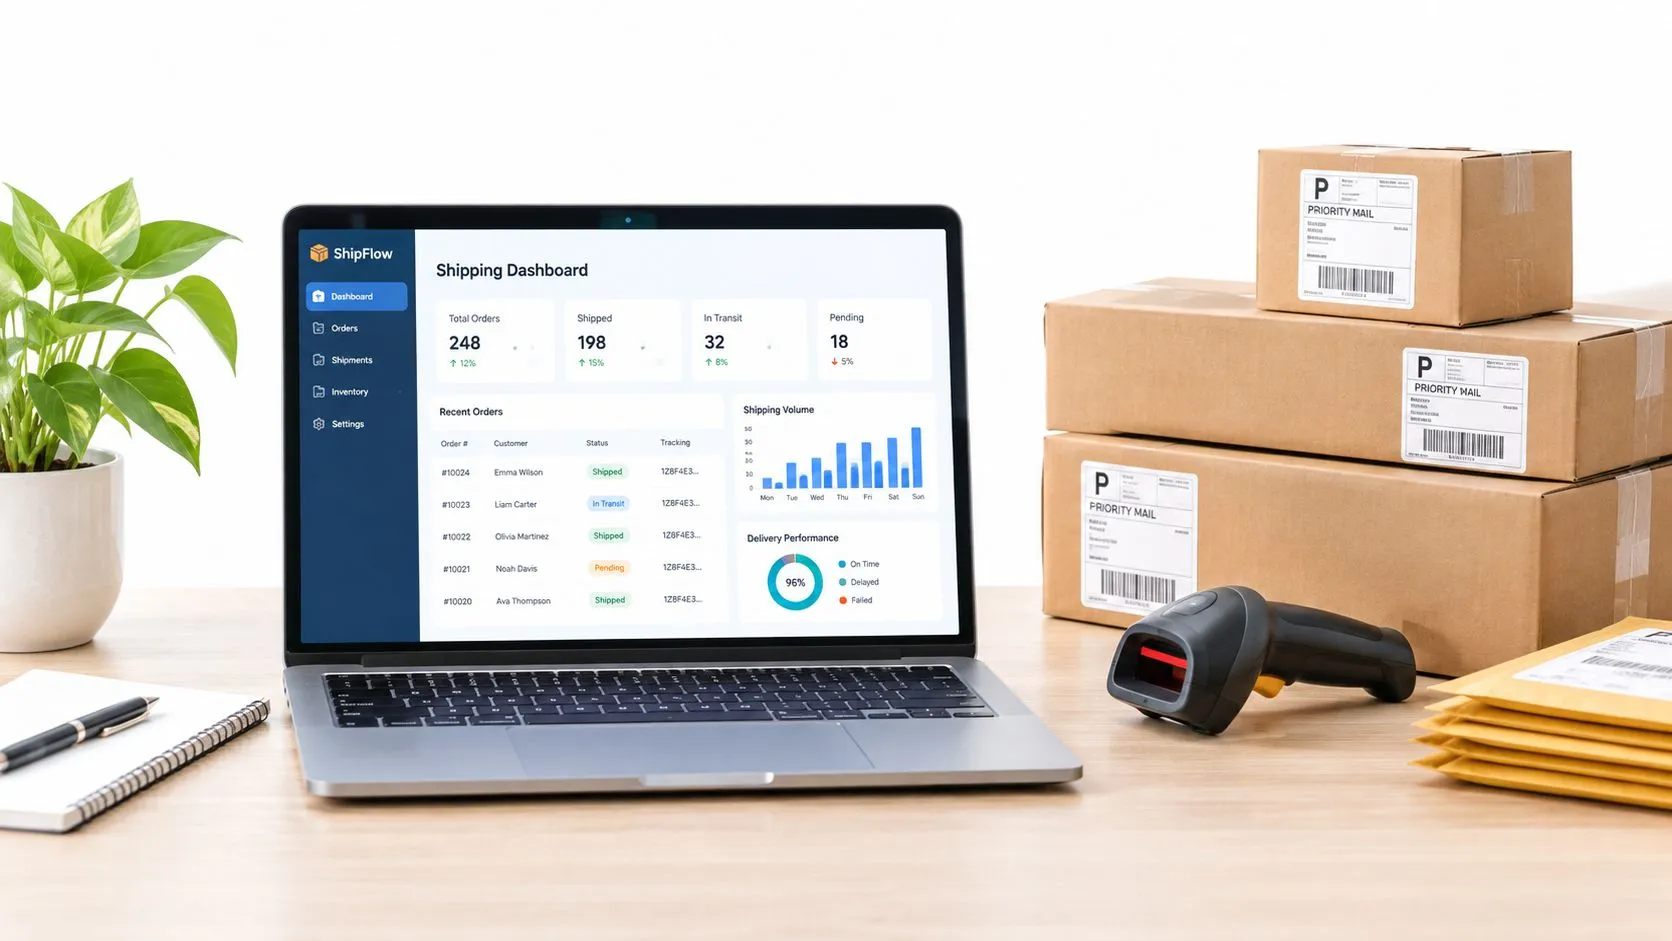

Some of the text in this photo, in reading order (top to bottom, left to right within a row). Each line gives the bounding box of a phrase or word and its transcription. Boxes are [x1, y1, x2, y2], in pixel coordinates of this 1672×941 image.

[1315, 177, 1328, 199] P
[1308, 205, 1374, 218] PRIORITY MAIL
[334, 248, 393, 263] ShipFlow
[437, 263, 588, 280] Shipping Dashboard
[449, 314, 500, 323] Total Orders
[578, 314, 612, 324] Shipped
[704, 314, 742, 323] In Transit
[830, 313, 864, 323] Pending
[332, 324, 358, 332] Orders
[450, 335, 480, 350] 248
[578, 334, 606, 349] 198
[705, 334, 724, 349] 32
[831, 334, 848, 348] 18
[332, 356, 373, 365] Shipments
[461, 360, 476, 368] 12%
[716, 358, 728, 366] 8%
[1418, 355, 1432, 378] P
[332, 388, 368, 397] Inventory
[1415, 383, 1481, 397] PRIORITY MAIL
[440, 408, 503, 416] Recent Orders
[744, 406, 780, 415] Shipping
[332, 420, 364, 429] Settings
[661, 439, 690, 447] Tracking
[593, 468, 622, 476] Shipped
[1096, 471, 1109, 495] P
[1090, 502, 1156, 519] PRIORITY MAIL
[443, 533, 471, 541] #10022
[594, 532, 623, 540] Shipped
[747, 534, 839, 544] Delivery Performance
[595, 564, 624, 572] Pending
[850, 560, 860, 568] On
[786, 578, 805, 587] 96%
[851, 578, 879, 587] Delayed
[512, 597, 551, 606] Thompson
[595, 596, 625, 605] Shipped
